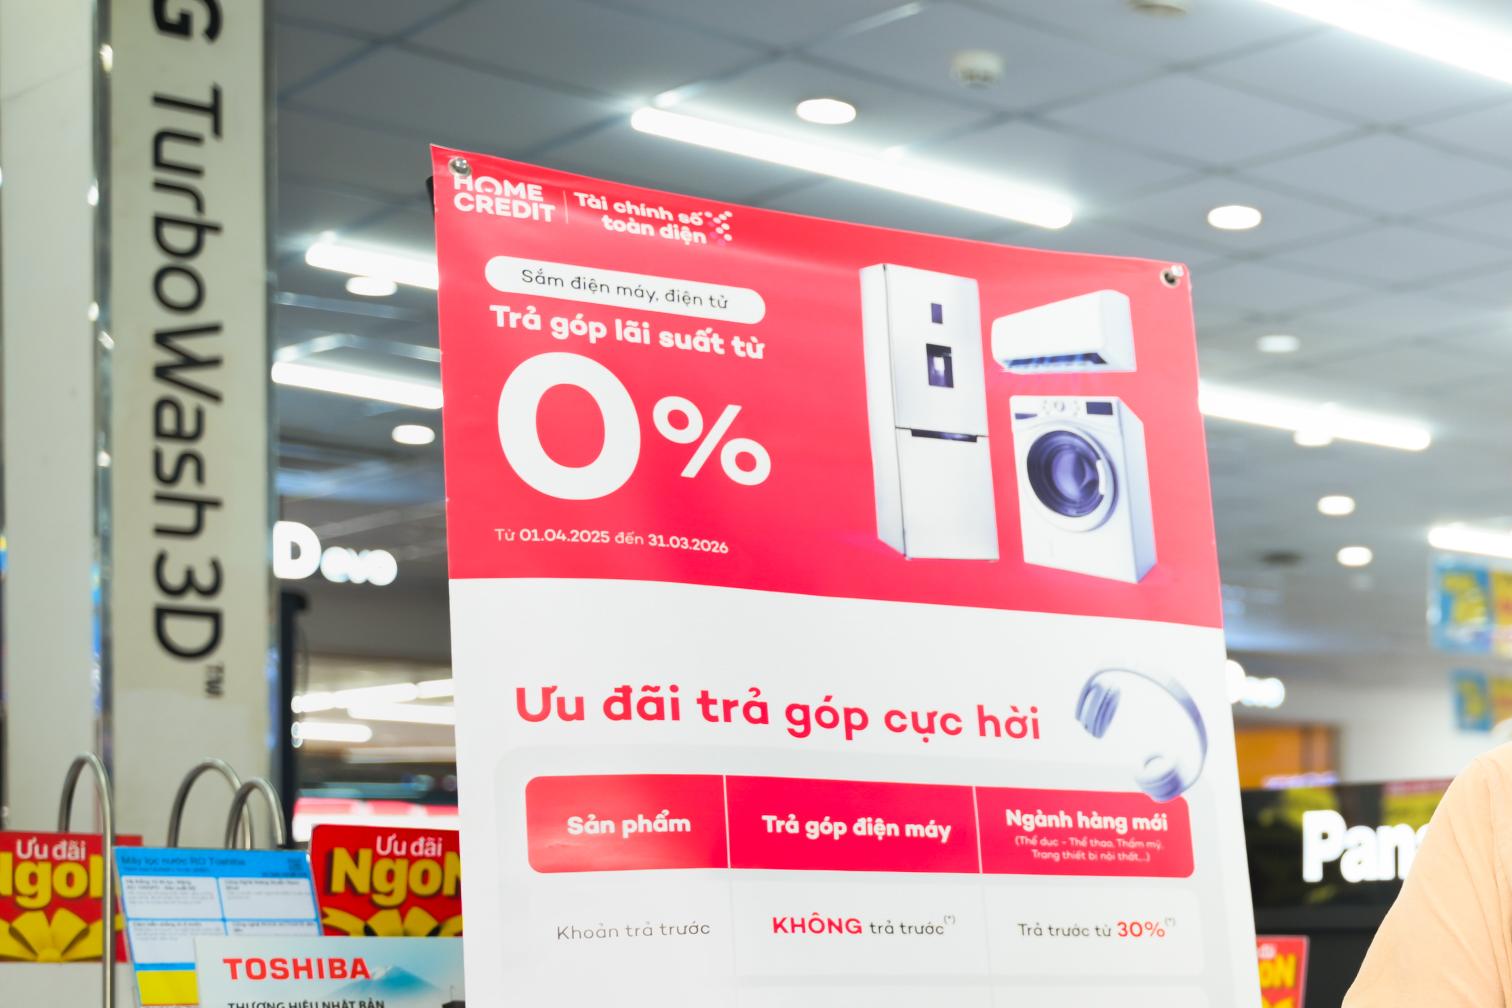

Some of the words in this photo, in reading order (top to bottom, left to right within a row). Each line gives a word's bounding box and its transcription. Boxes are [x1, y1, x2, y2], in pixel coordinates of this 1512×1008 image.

[454, 174, 544, 202] HOME
[453, 191, 556, 223] CREDIT
[573, 190, 609, 211] Tài
[612, 198, 673, 221] chính
[677, 209, 704, 227] số
[601, 214, 655, 237] toàn
[659, 221, 707, 246] diện
[520, 267, 565, 288] Sắm
[570, 274, 611, 296] điện
[665, 288, 703, 307] điện
[708, 293, 729, 309] tử
[489, 304, 542, 331] Trả
[551, 313, 608, 344] góp
[615, 318, 651, 345] lãi
[659, 326, 725, 356] suất
[731, 336, 766, 360] từ
[518, 527, 611, 544] 01.04.2025
[614, 530, 645, 546] đến
[647, 533, 730, 554] 31.03.2026
[515, 683, 586, 723] Ưu
[601, 684, 682, 723] đãi
[697, 686, 771, 726] trả
[785, 695, 869, 741] góp
[882, 708, 964, 743] cực
[976, 703, 1042, 741] hời
[566, 813, 616, 836] Sản
[621, 809, 692, 839] phẩm
[762, 813, 801, 836] Trả
[804, 815, 848, 841] góp
[852, 814, 901, 842] điện
[904, 819, 953, 845] máy
[1005, 808, 1073, 832] Ngành
[1076, 810, 1128, 835] hàng
[1131, 812, 1168, 832] mới
[16, 836, 49, 860] Ưu
[51, 839, 87, 862] đãi
[375, 833, 408, 857] Ưu
[409, 836, 443, 857] đãi
[624, 920, 654, 938] trả
[658, 919, 712, 937] trước
[223, 956, 371, 981] TOSHIBA
